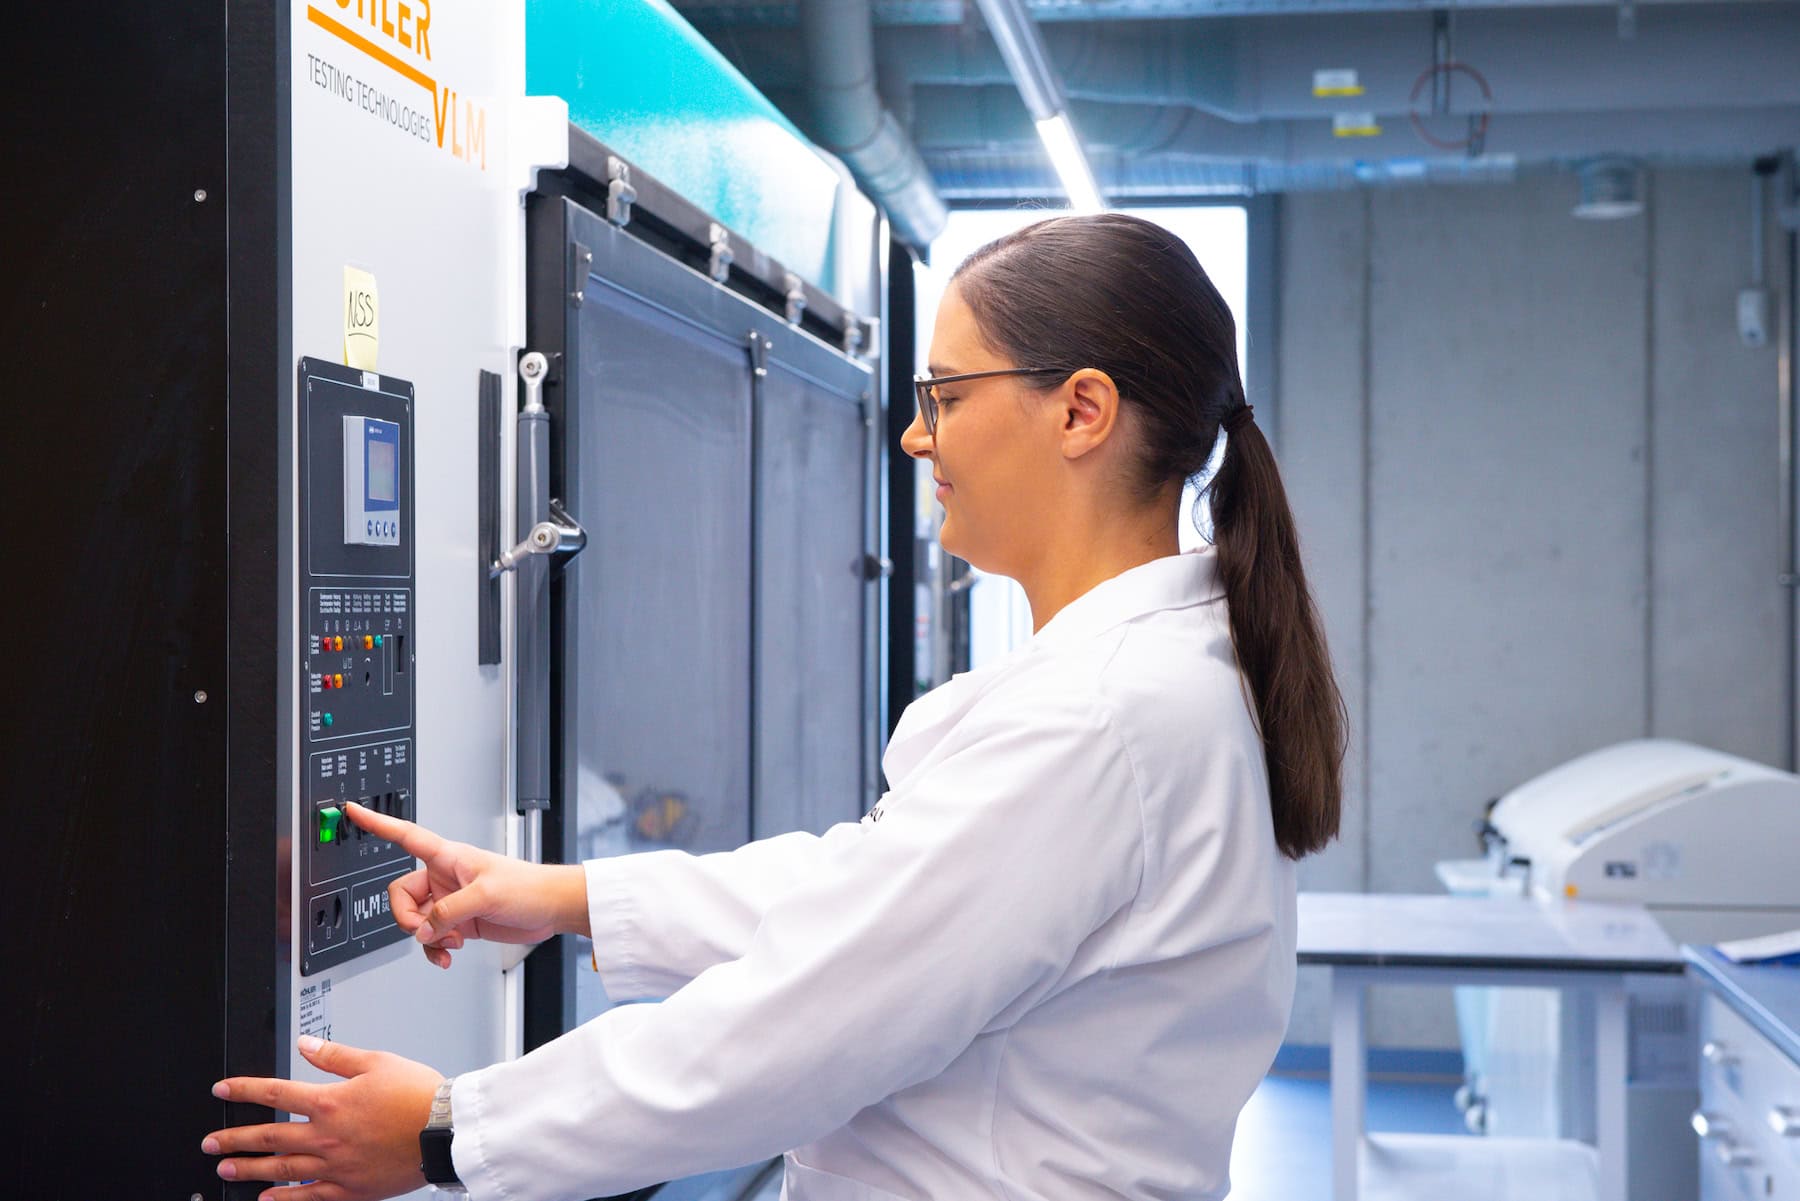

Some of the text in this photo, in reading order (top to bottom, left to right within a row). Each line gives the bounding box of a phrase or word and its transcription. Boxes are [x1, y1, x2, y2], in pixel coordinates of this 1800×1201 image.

[307, 53, 431, 143] TESTING TECHNOLOGIES
[432, 82, 486, 171] VLM
[348, 290, 374, 328] NSS
